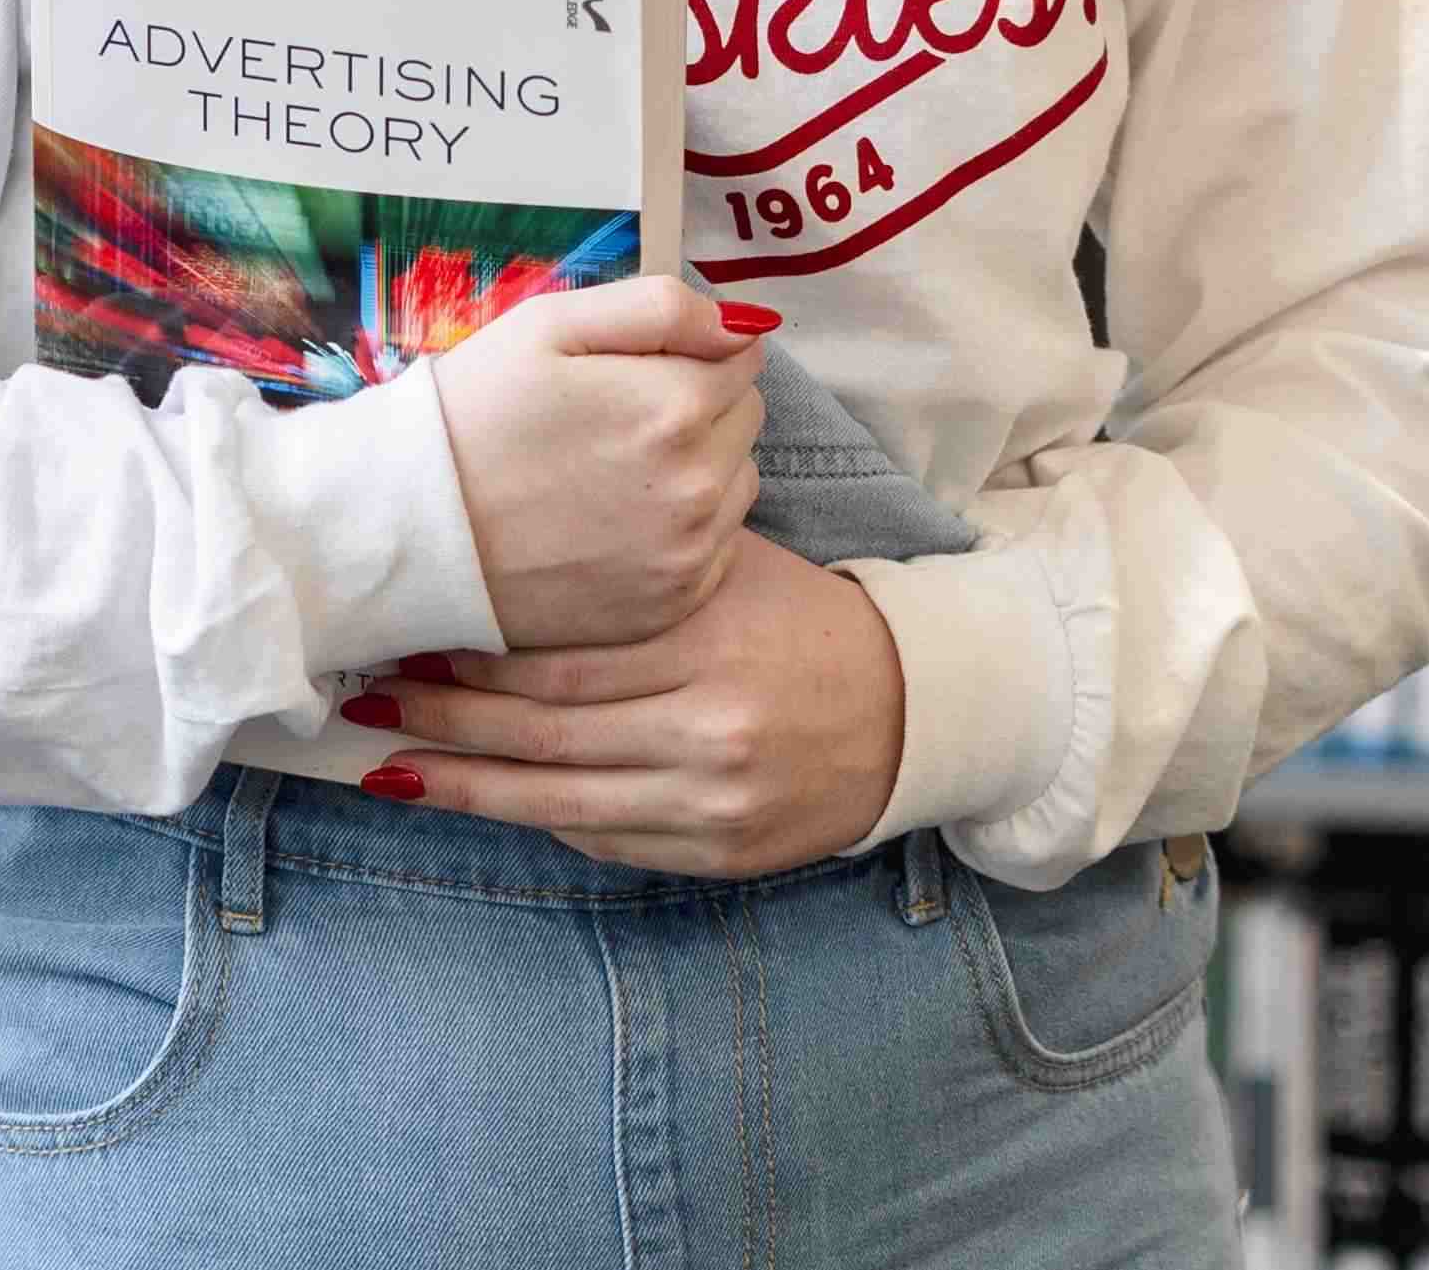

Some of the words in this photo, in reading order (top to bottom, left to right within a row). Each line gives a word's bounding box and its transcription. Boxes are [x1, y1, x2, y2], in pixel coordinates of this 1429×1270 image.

[98, 18, 561, 117] ADVERTISING
[187, 87, 470, 165] THEORY
[725, 136, 895, 242] 1964
